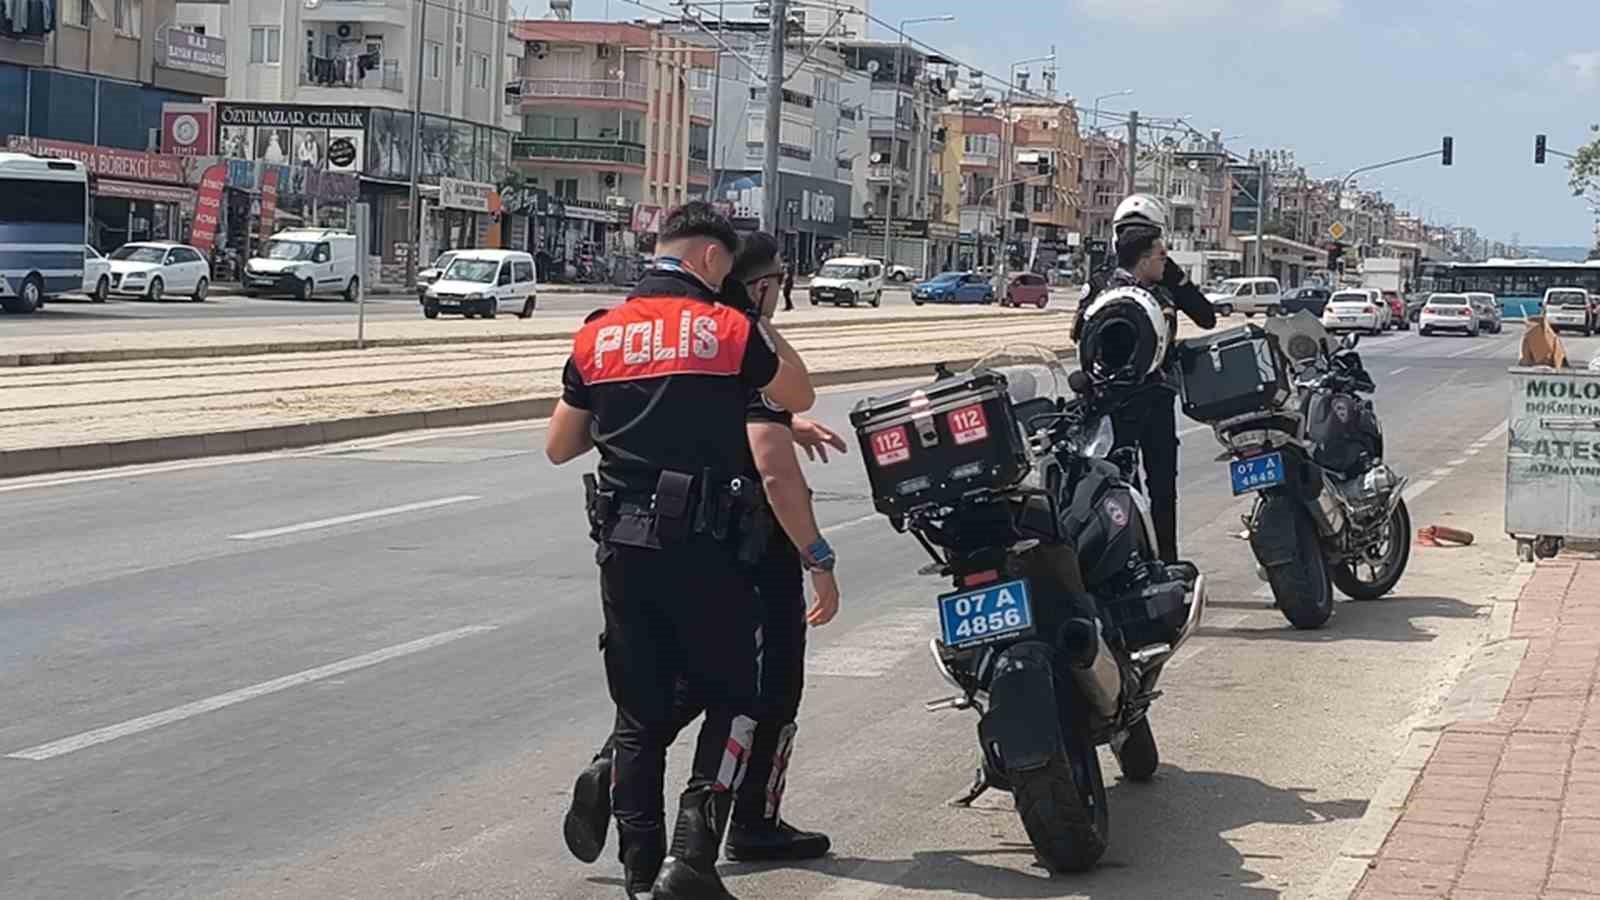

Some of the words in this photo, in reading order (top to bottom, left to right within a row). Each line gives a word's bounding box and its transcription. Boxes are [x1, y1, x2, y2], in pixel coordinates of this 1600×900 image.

[221, 106, 304, 124] ÖZYILMAZLAR
[953, 410, 981, 430] 112
[875, 431, 904, 453] 112
[1237, 462, 1254, 475] 07
[1265, 457, 1276, 469] A
[955, 593, 987, 617] 07
[996, 588, 1016, 608] A
[956, 608, 1021, 637] 4856
